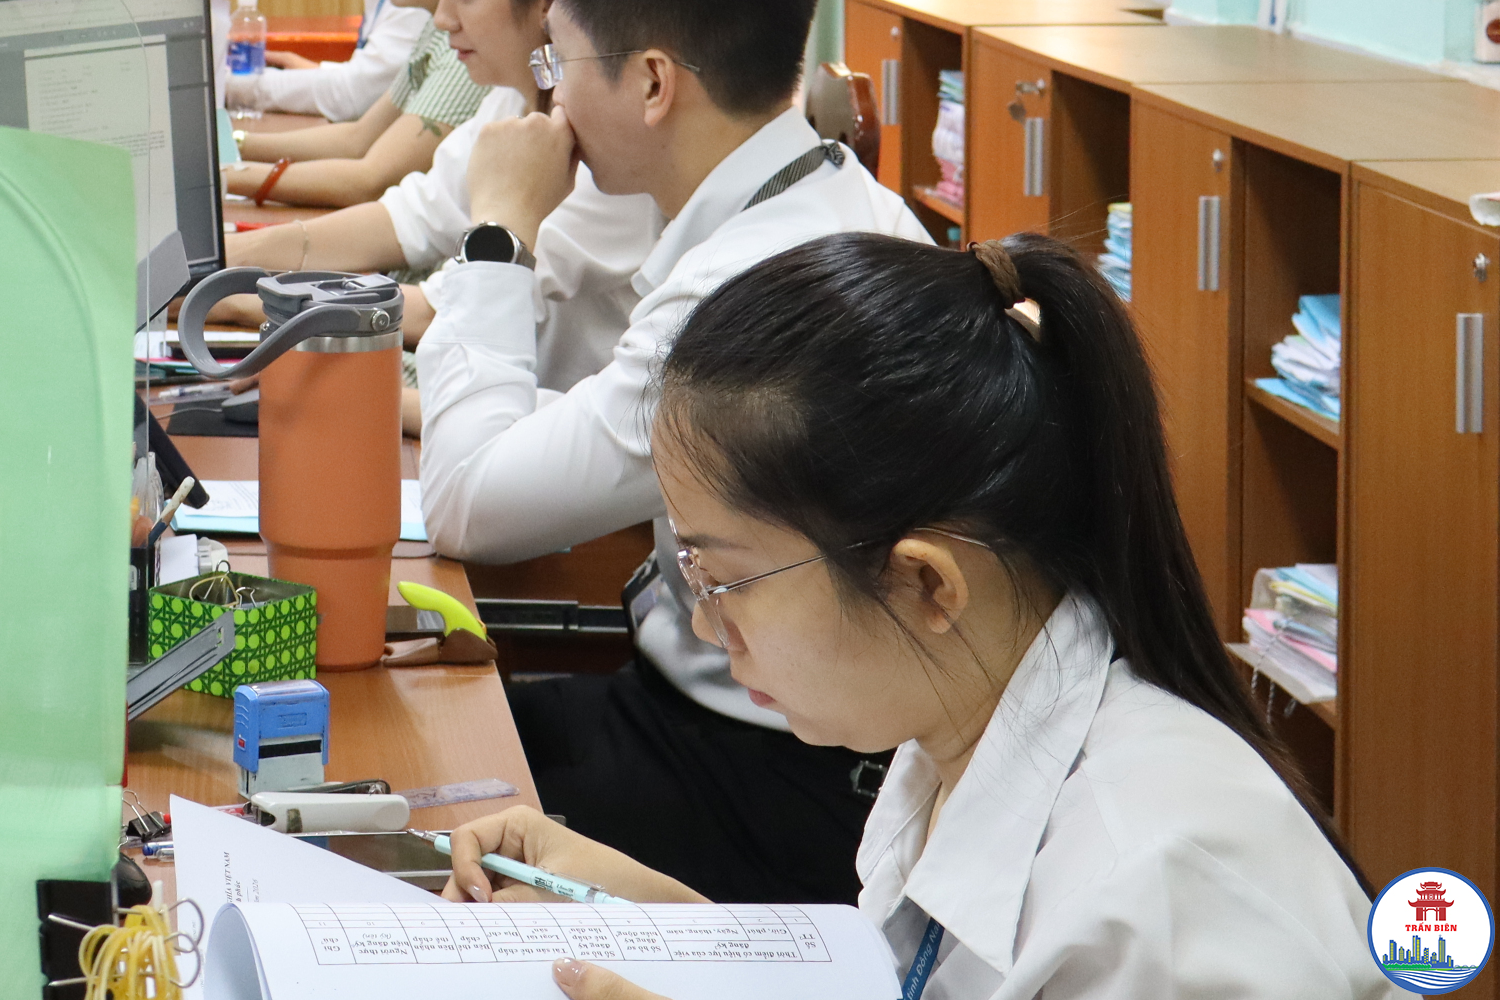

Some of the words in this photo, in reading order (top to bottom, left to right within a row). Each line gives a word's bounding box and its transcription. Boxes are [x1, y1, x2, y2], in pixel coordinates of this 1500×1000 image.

[223, 851, 231, 868] NAM
[224, 869, 232, 886] VIỆT
[498, 947, 518, 955] chấp
[650, 945, 661, 953] Số
[755, 951, 774, 959] điểm
[916, 943, 933, 976] Đồng
